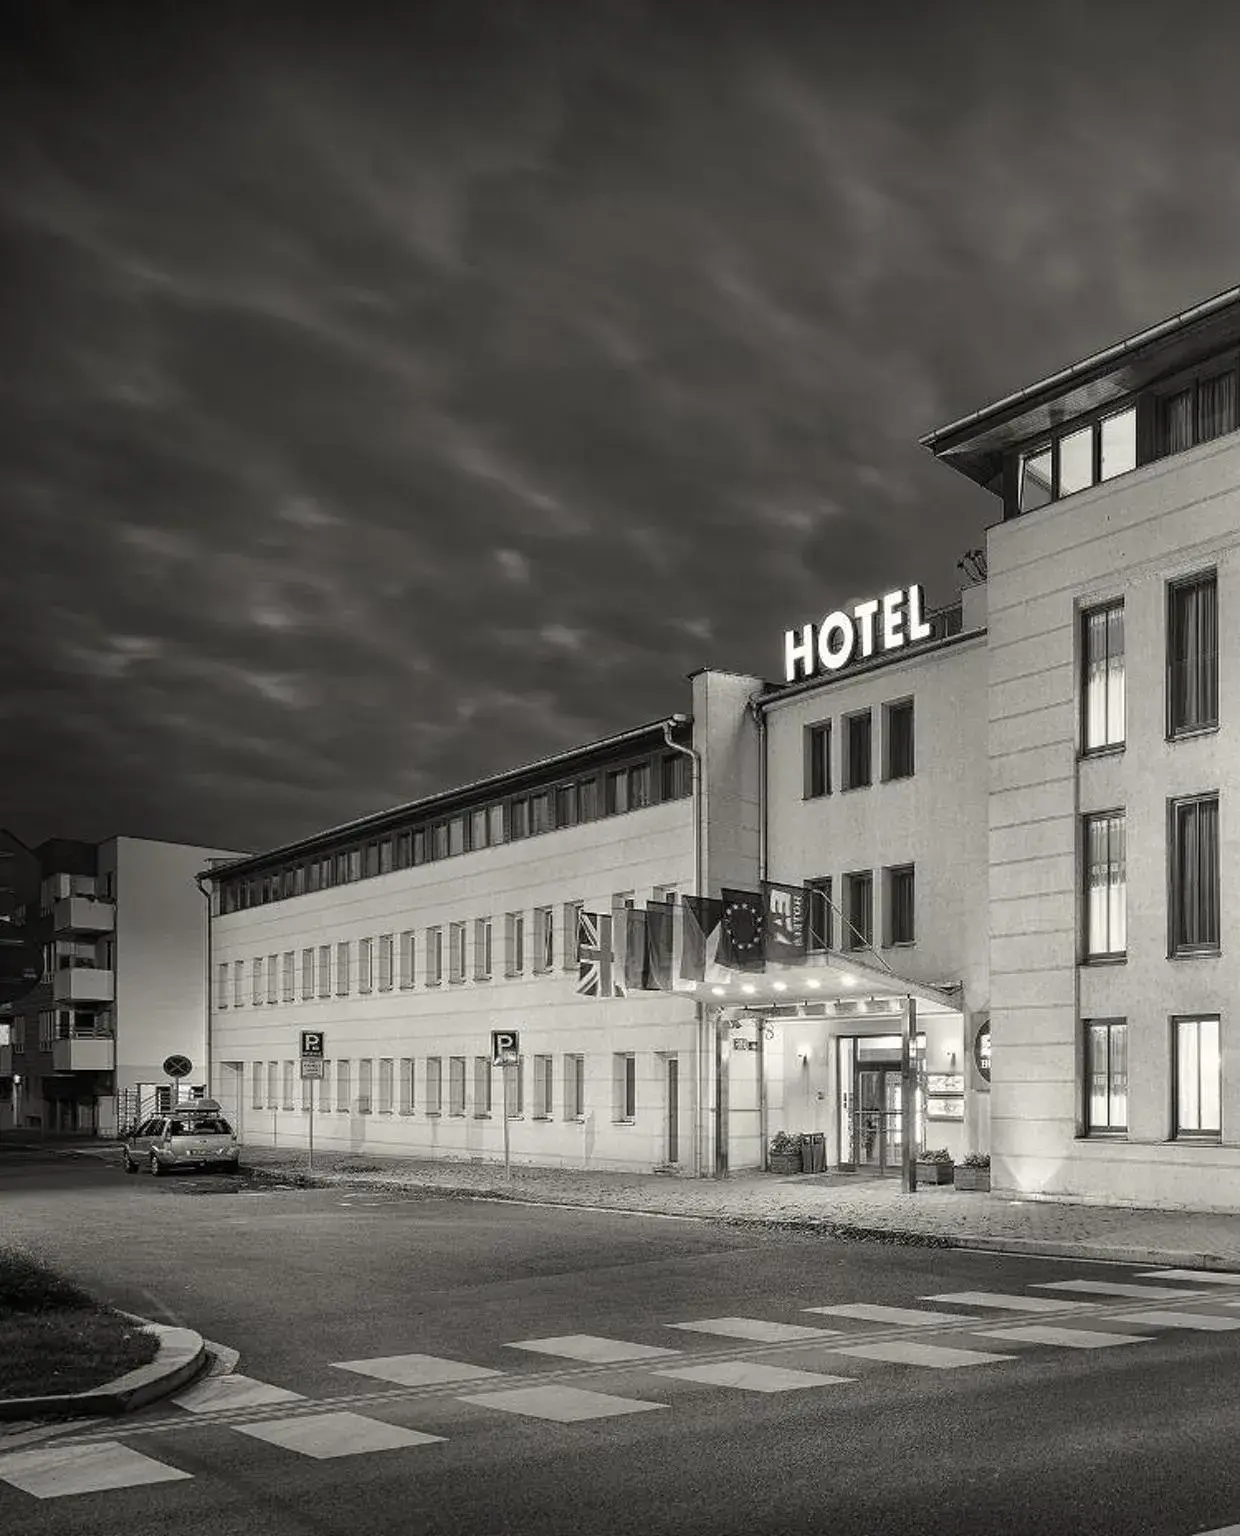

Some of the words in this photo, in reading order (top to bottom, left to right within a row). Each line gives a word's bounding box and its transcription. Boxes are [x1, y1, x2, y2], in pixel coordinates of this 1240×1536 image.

[784, 584, 931, 682] HOTEL
[305, 1034, 319, 1050] P
[498, 1034, 513, 1055] P
